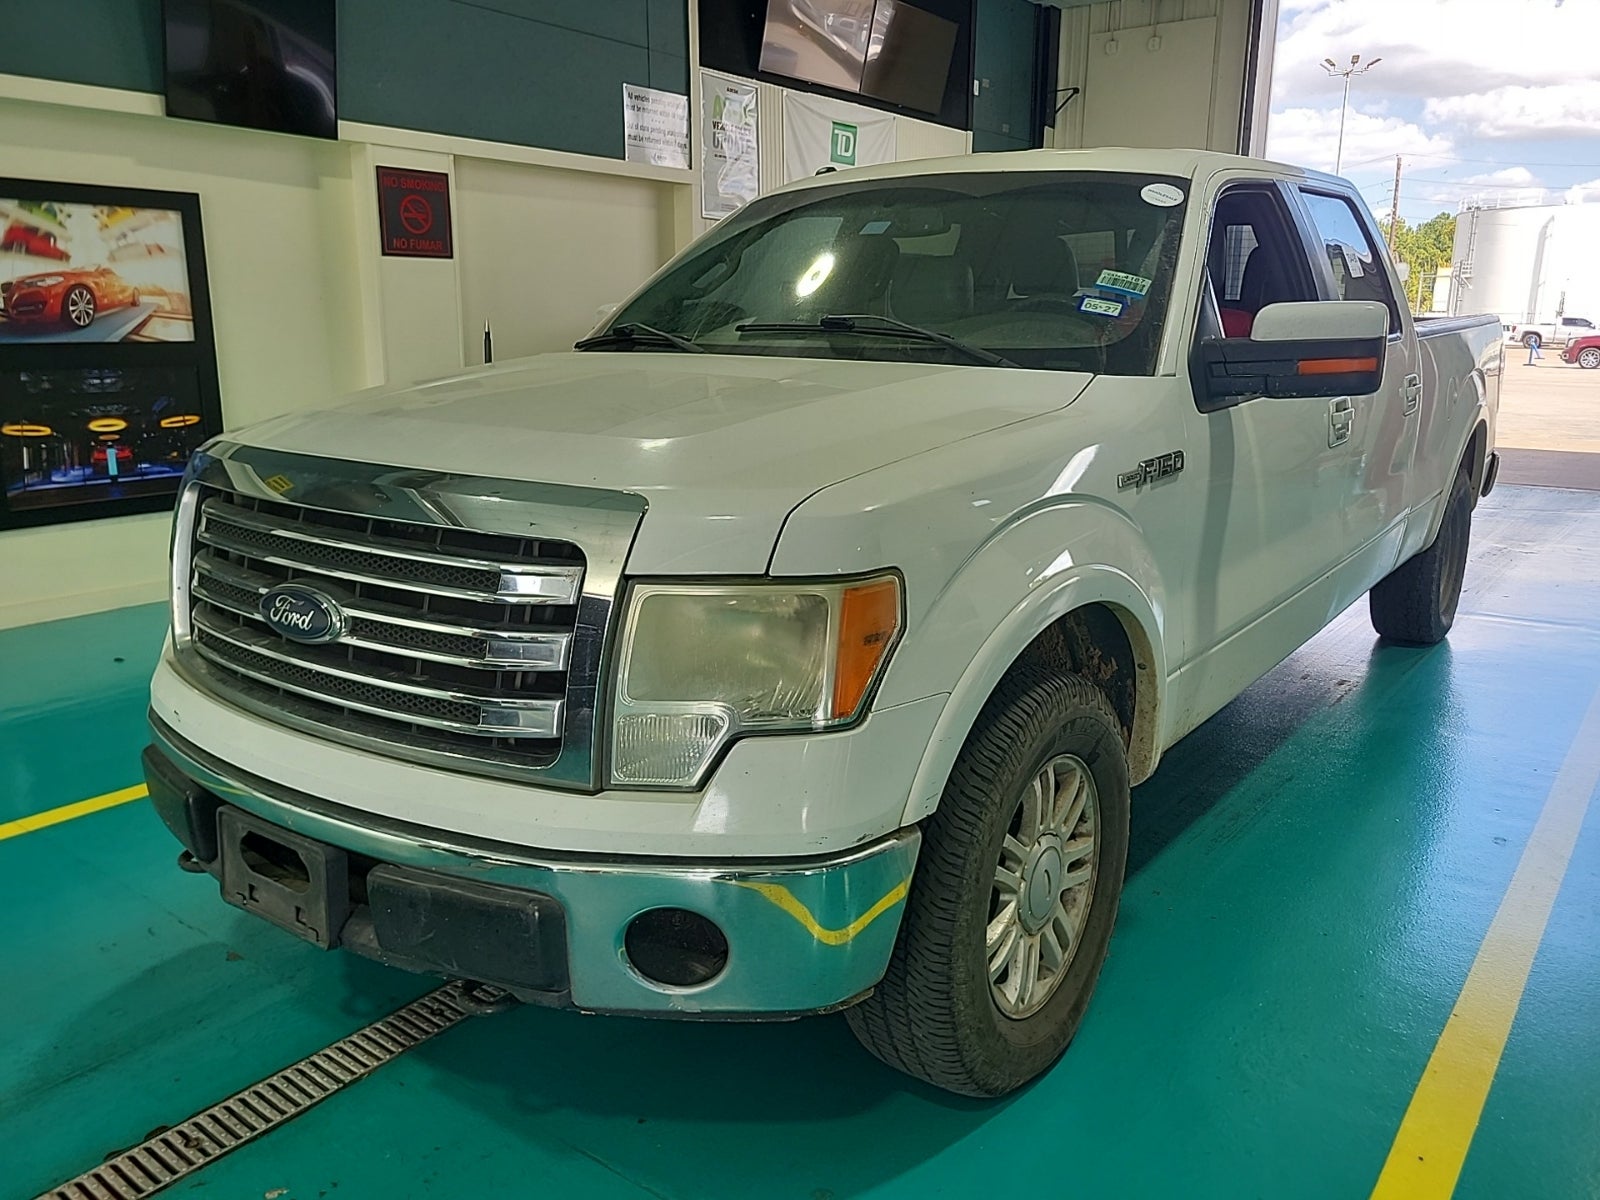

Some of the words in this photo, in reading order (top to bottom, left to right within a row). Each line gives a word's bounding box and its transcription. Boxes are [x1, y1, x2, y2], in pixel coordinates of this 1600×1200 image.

[834, 129, 855, 157] TD
[383, 176, 398, 188] NO
[400, 178, 446, 192] SMOKING
[393, 238, 408, 249] NO
[410, 239, 443, 250] FUMAR
[270, 595, 315, 630] Ford
